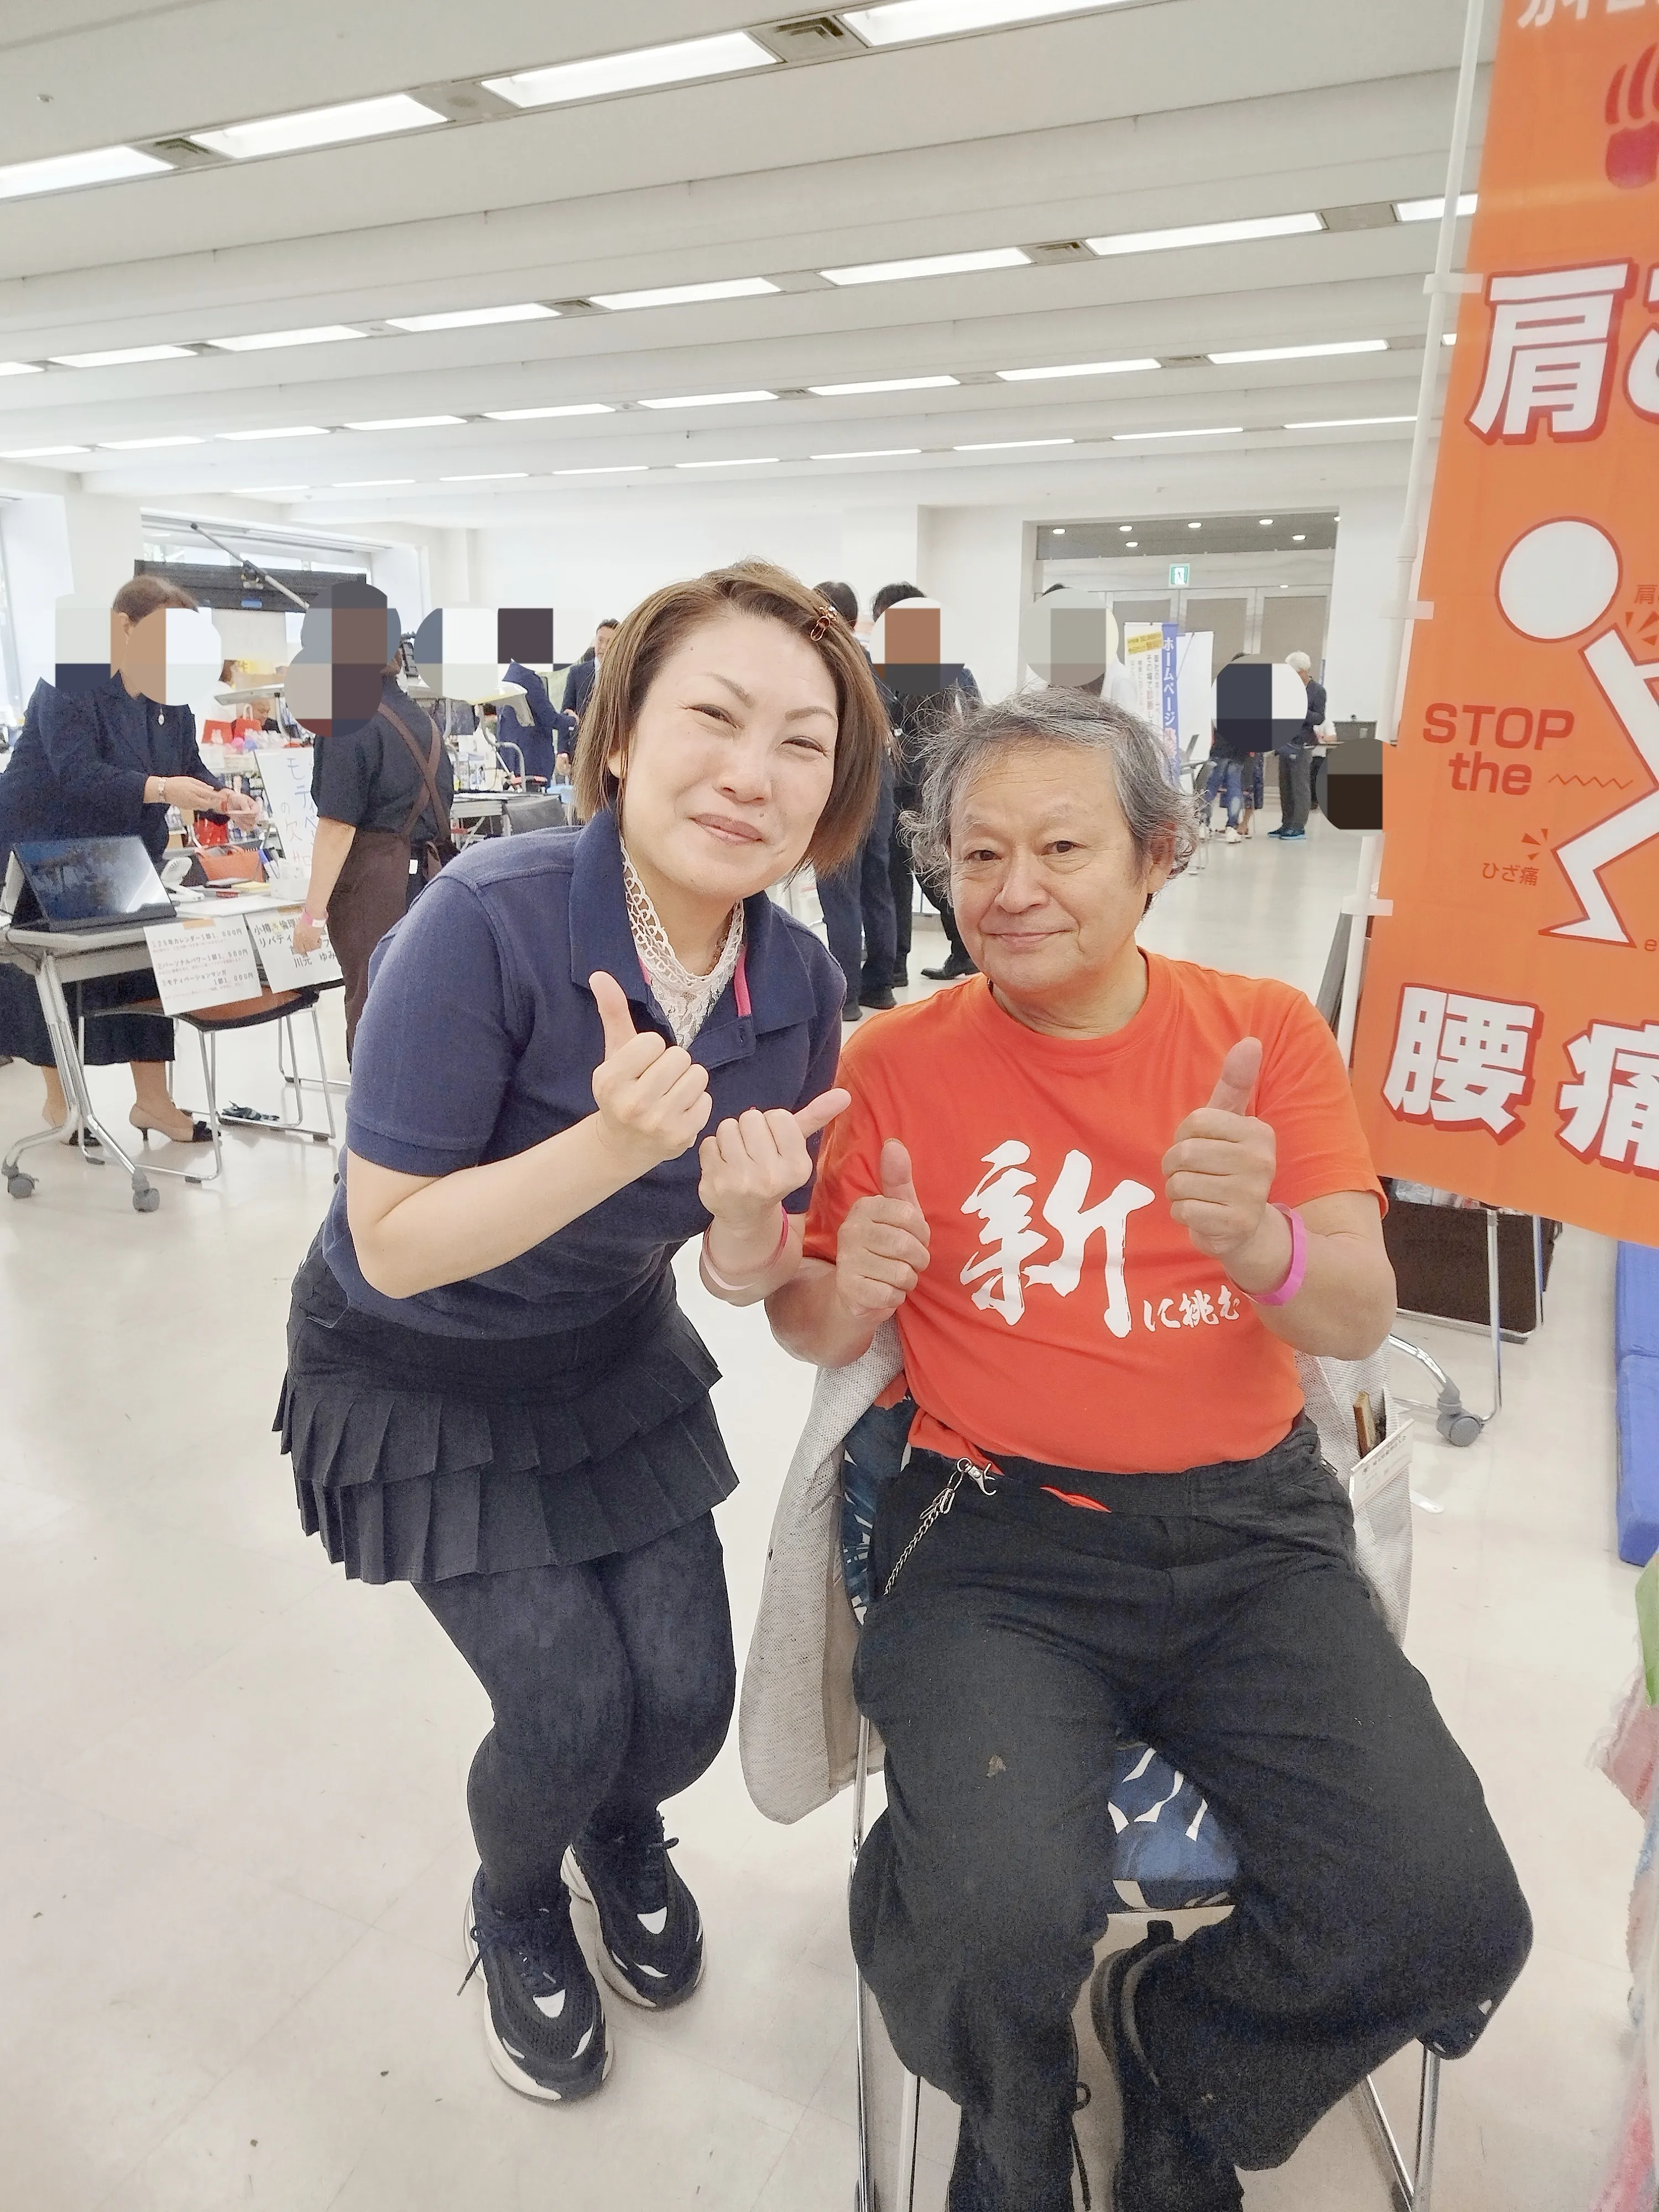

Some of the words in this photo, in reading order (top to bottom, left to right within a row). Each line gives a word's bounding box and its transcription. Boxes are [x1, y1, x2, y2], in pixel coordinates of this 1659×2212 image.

[1465, 257, 1659, 442] 肩
[1634, 585, 1659, 604] 肩
[1163, 637, 1176, 726] ホームページ
[1423, 703, 1575, 750] STOP
[1448, 751, 1532, 795] the
[1483, 863, 1539, 886] ひざ痛
[1383, 983, 1659, 1182] 腰痛
[959, 1140, 1156, 1338] 新
[1143, 1284, 1240, 1332] に挑む
